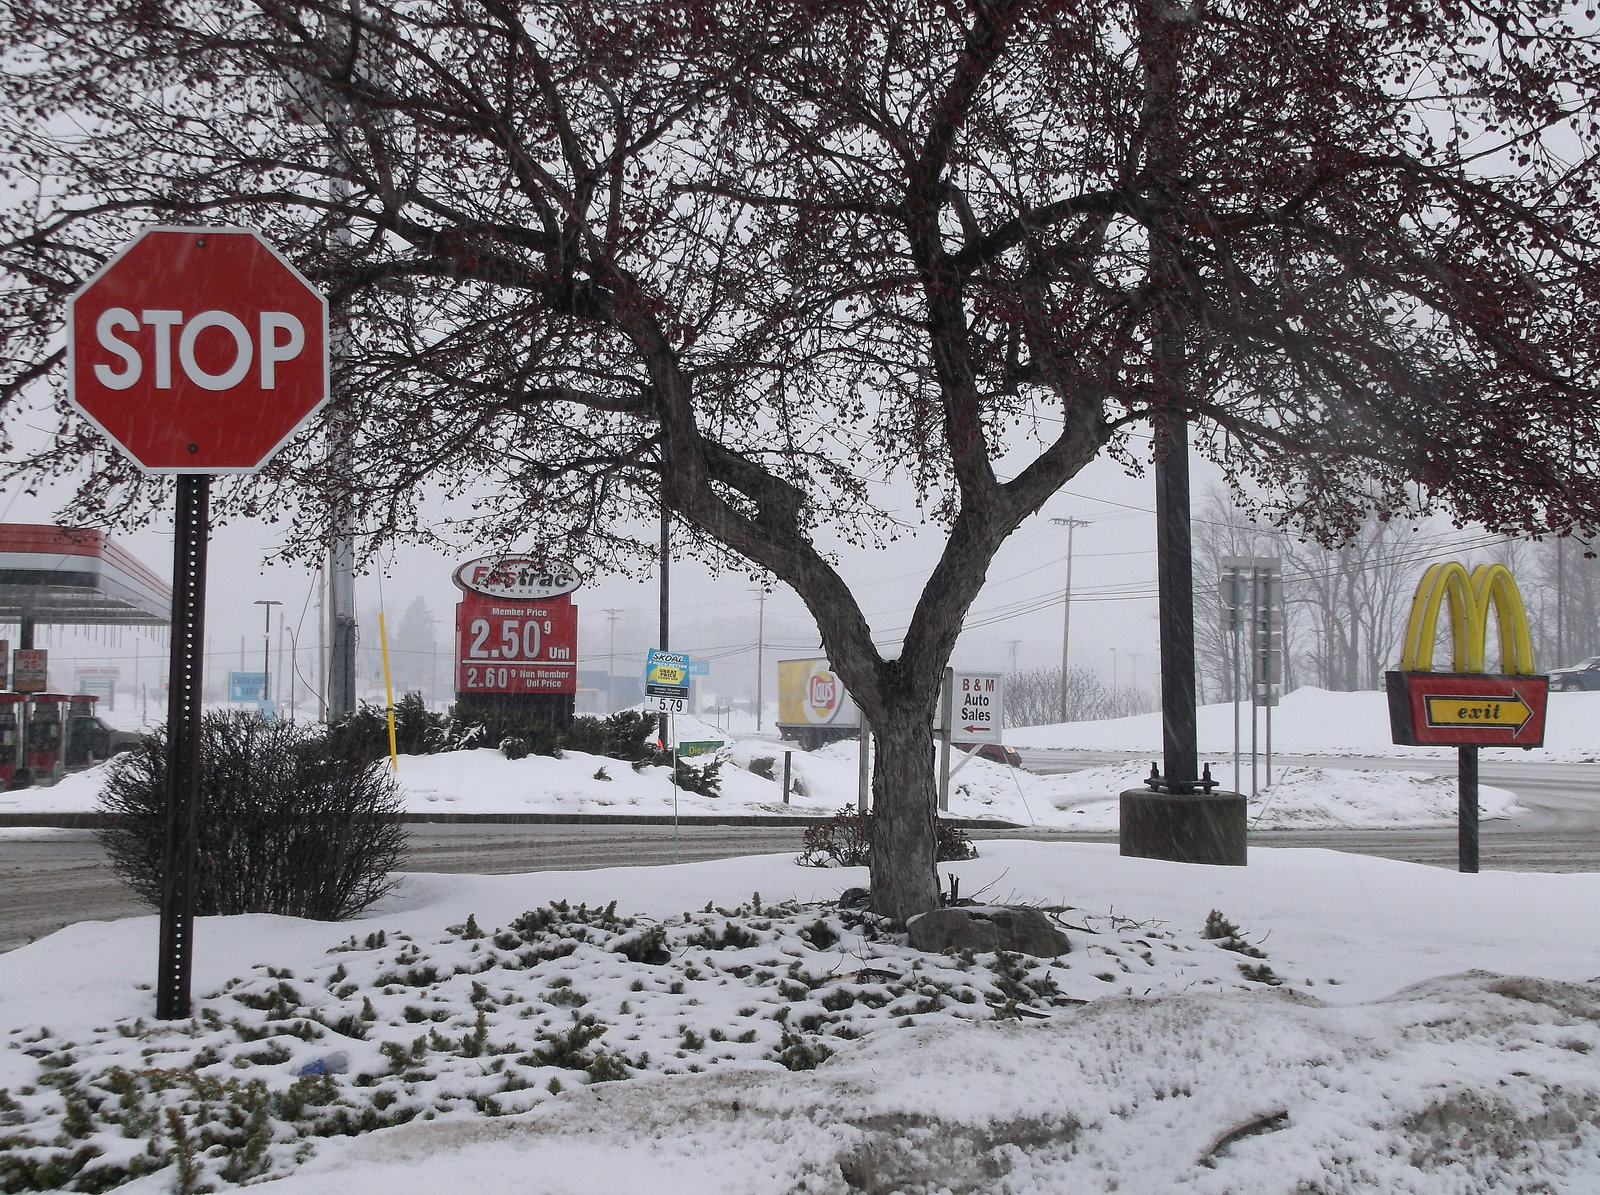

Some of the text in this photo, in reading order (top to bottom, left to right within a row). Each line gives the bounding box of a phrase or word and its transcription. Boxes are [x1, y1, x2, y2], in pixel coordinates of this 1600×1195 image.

[93, 307, 305, 391] STOP
[492, 608, 548, 617] Member Price
[470, 618, 542, 659] 2.50
[653, 652, 684, 662] SKOAL
[468, 667, 508, 688] 2.60
[520, 670, 536, 678] Non
[538, 670, 570, 679] Member
[541, 680, 562, 688] Price
[962, 678, 995, 692] B & M
[659, 698, 683, 712] 5.79
[964, 693, 990, 707] Auto
[961, 708, 991, 722] Sales
[1457, 704, 1501, 720] exit
[688, 746, 708, 754] Dies
